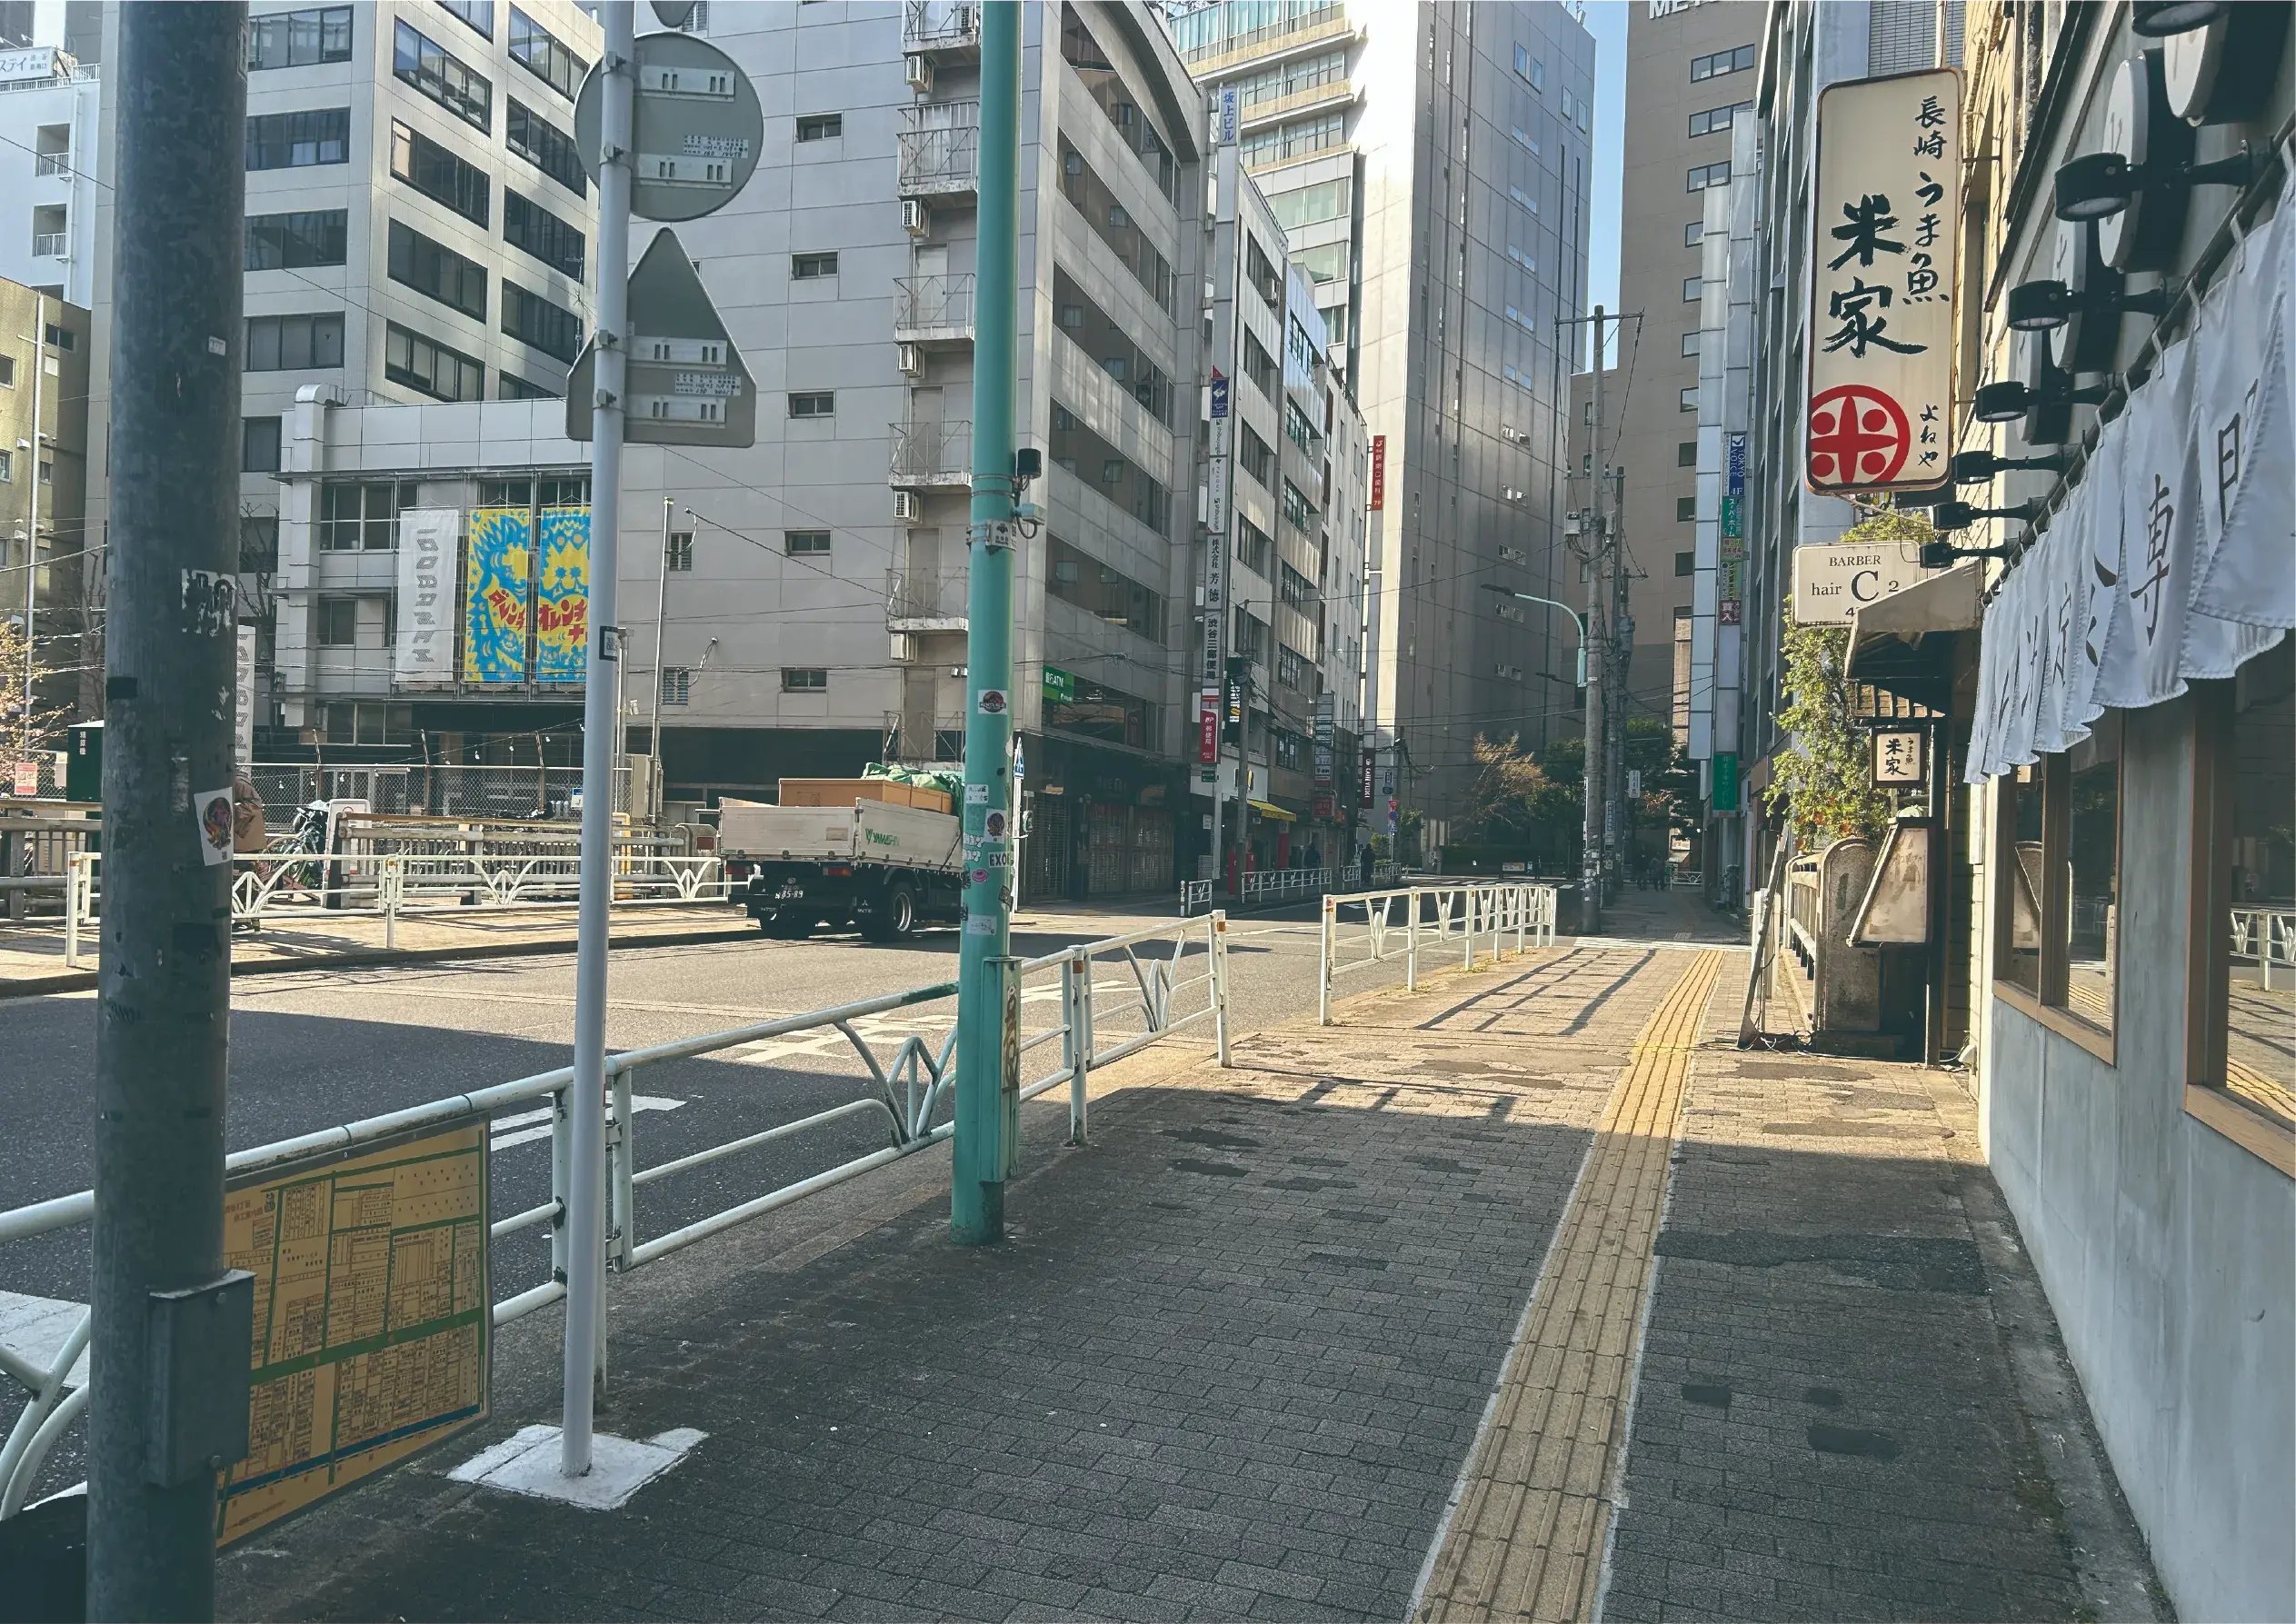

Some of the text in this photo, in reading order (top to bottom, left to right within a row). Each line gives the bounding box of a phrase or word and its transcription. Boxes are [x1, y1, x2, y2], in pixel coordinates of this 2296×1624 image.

[1223, 92, 1234, 142] 坂上ビル
[1912, 95, 1947, 160] 長崎
[1822, 193, 1929, 359] 米家
[1917, 404, 1939, 468] よねや
[1737, 449, 1745, 477] TOKYO
[1830, 555, 1882, 567] BARBER
[1812, 570, 1900, 602] hair C 2
[1884, 737, 1909, 775] 米家
